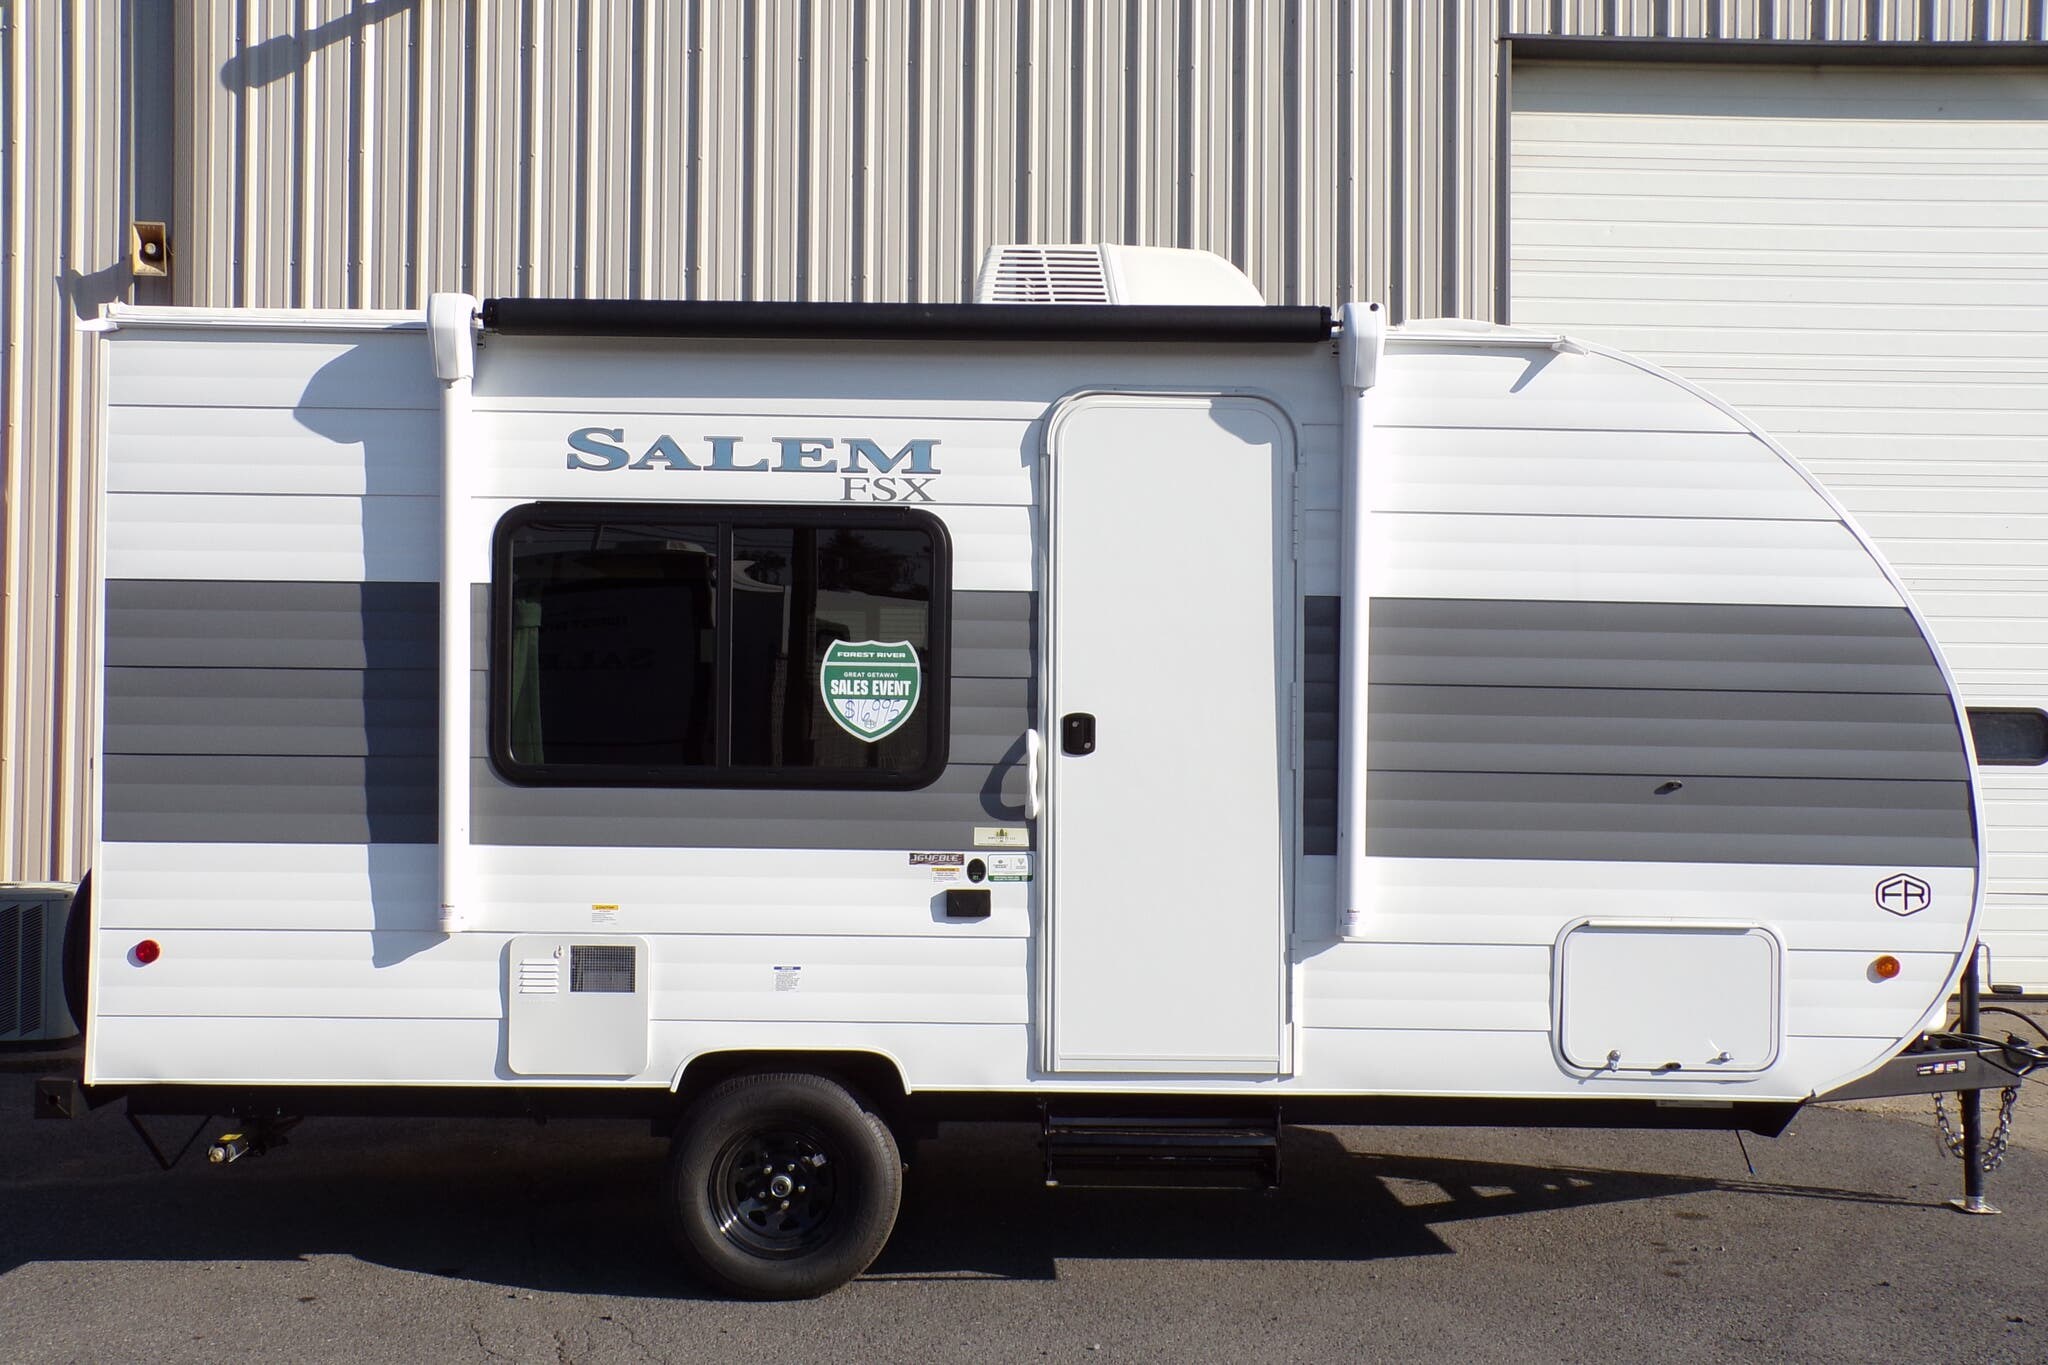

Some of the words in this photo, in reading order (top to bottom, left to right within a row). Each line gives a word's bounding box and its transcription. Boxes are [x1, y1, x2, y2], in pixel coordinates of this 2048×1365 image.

[566, 427, 942, 475] SALEM
[840, 476, 936, 501] FSX
[830, 679, 869, 696] SALES
[872, 680, 912, 697] EVENT
